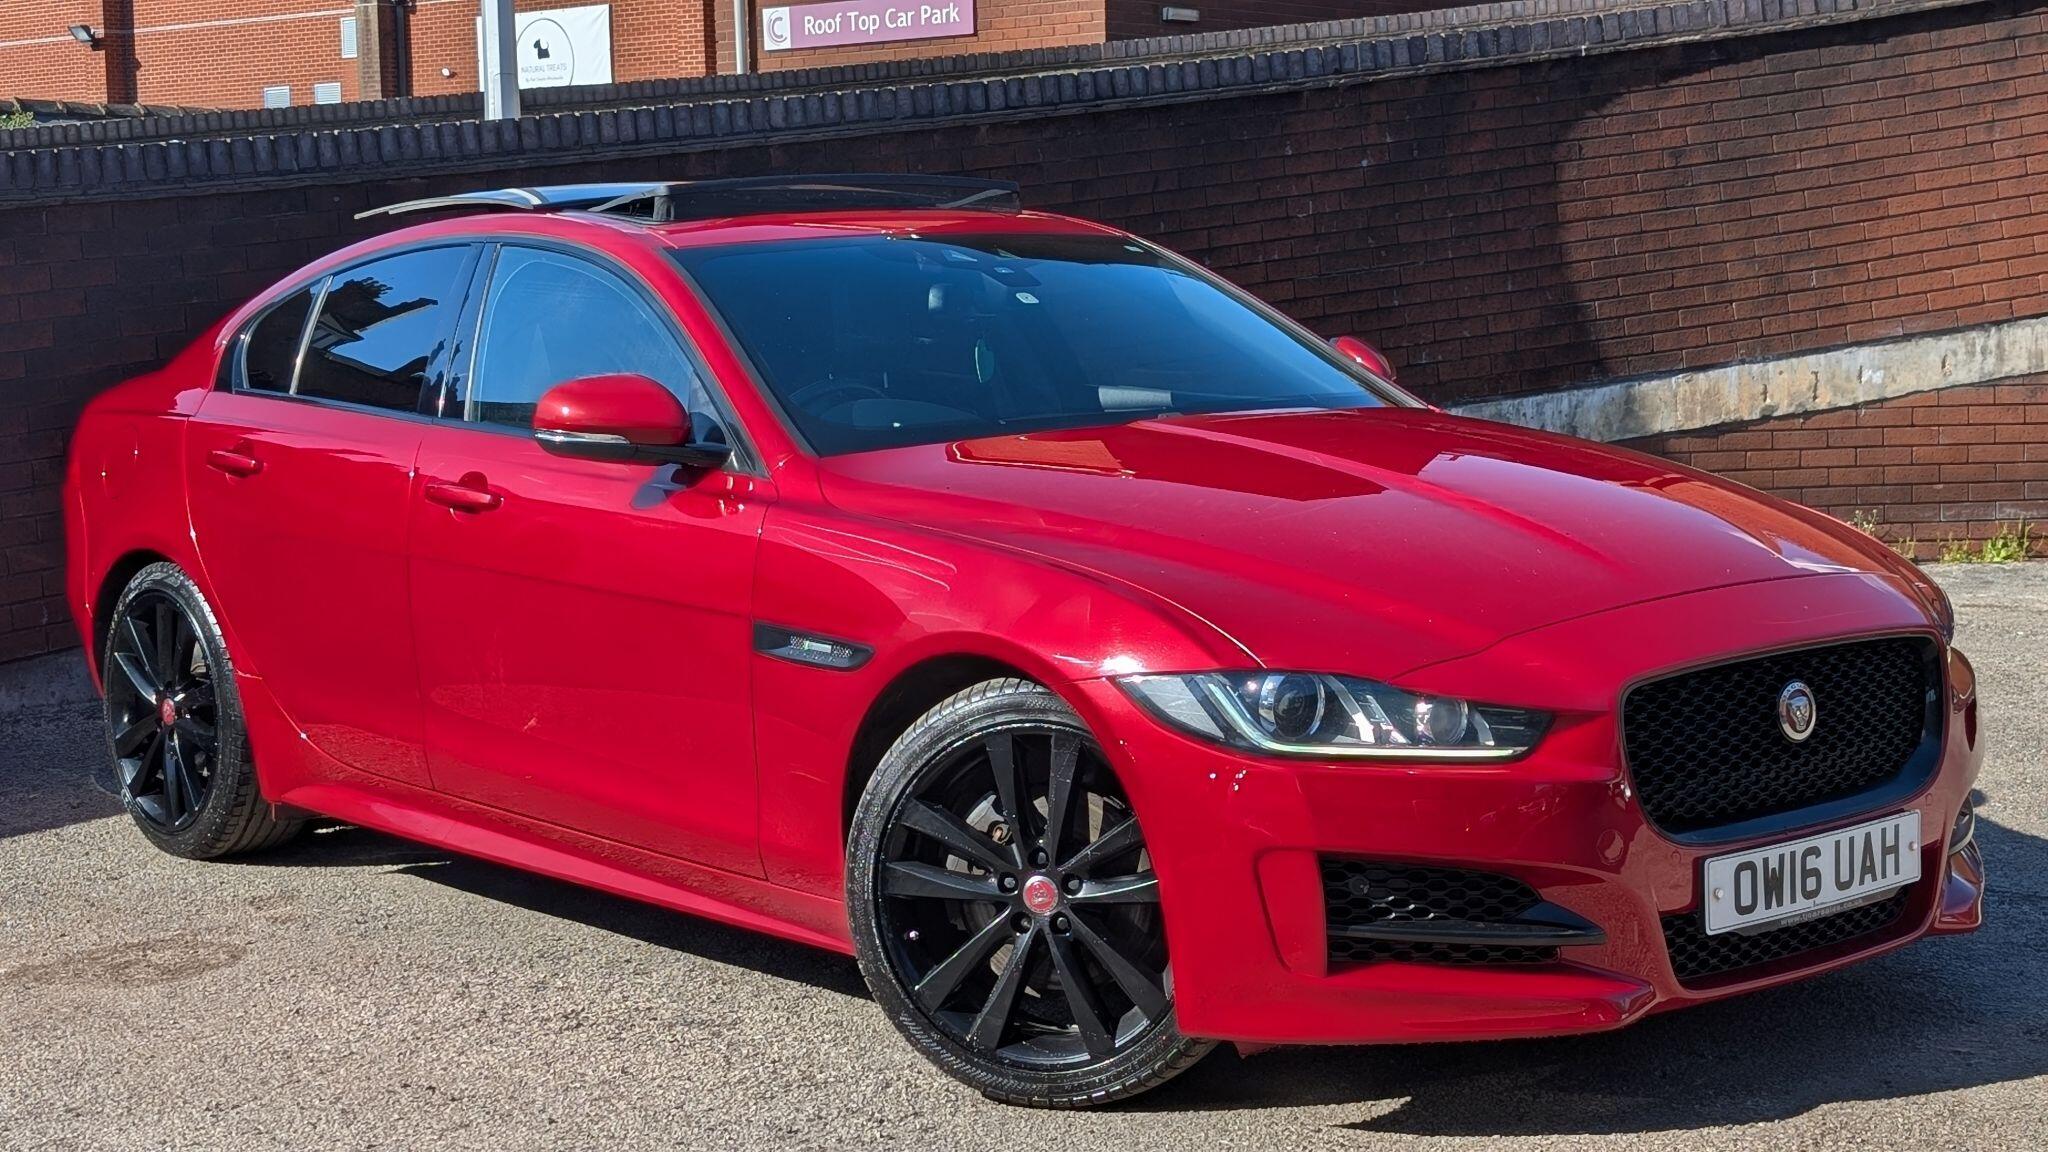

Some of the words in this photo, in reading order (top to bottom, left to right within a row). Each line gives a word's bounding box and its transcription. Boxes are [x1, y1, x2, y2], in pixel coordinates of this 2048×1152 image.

[804, 13, 842, 35] Roof
[847, 11, 880, 35] Top
[885, 8, 915, 28] Car
[920, 2, 960, 25] Park
[1733, 845, 1822, 916] OW16
[1834, 823, 1900, 891] UAH
